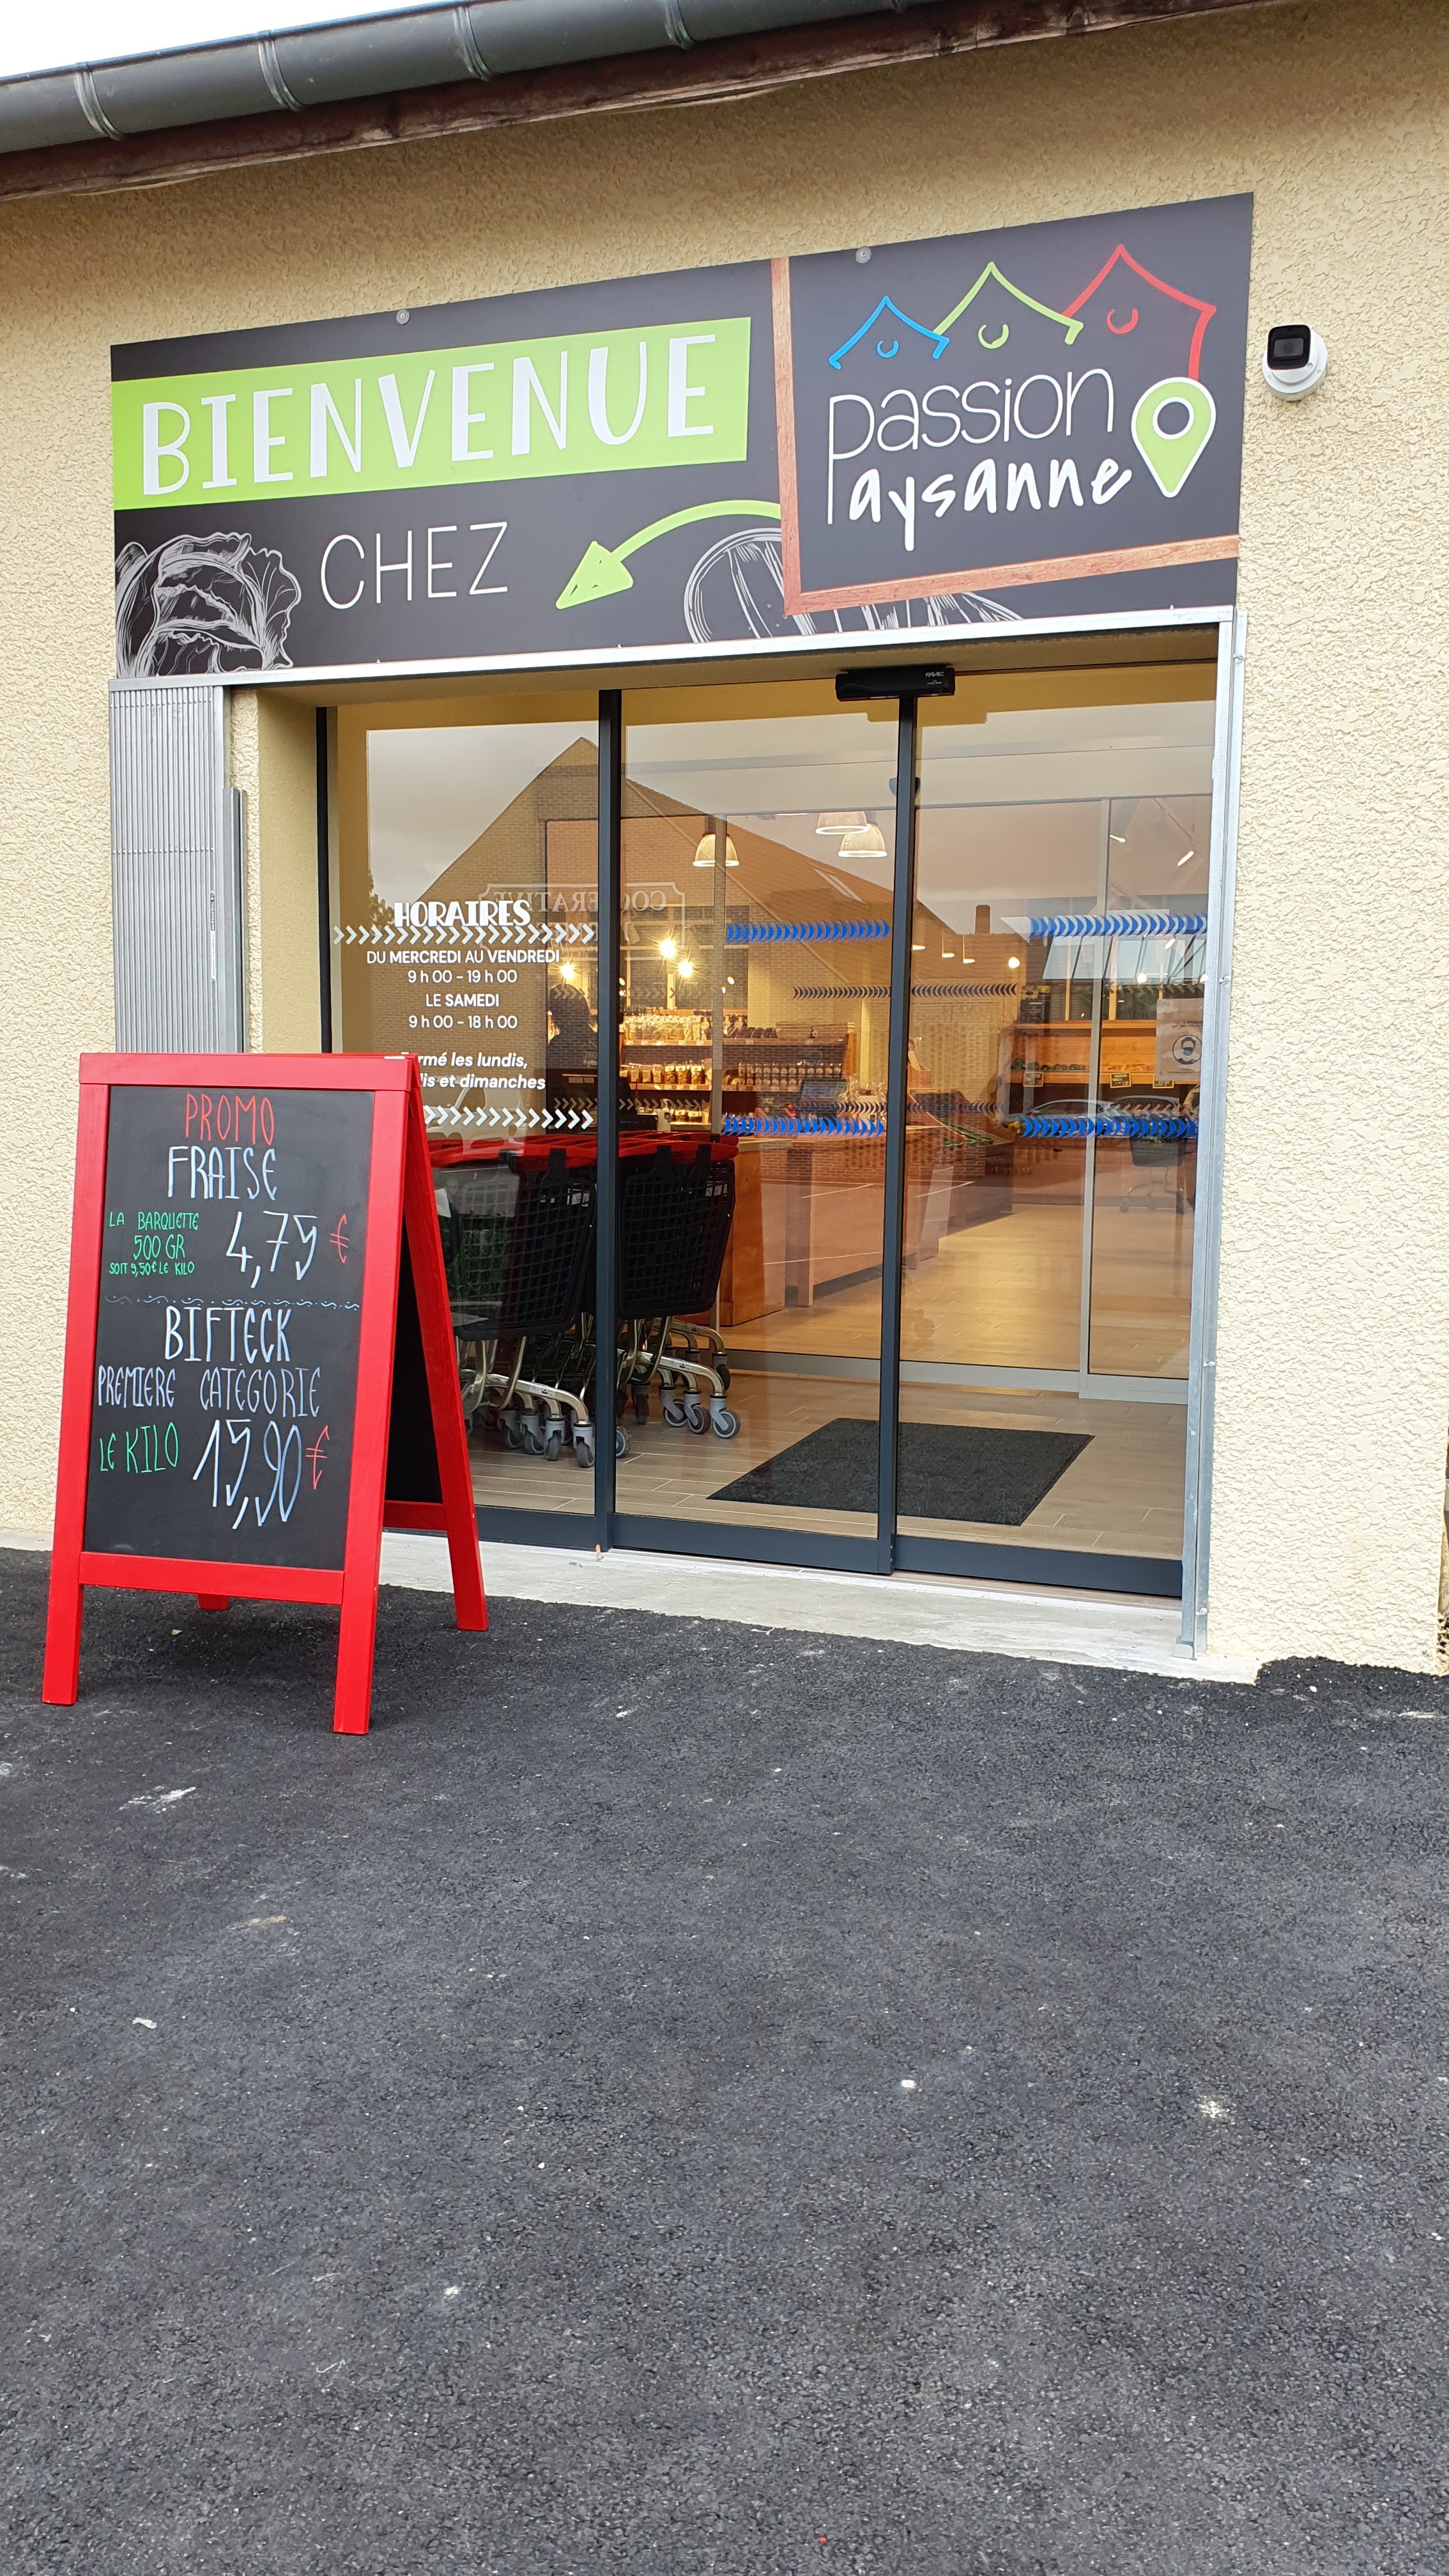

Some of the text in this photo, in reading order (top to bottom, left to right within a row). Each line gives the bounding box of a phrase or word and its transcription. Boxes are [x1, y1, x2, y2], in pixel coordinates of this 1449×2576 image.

[142, 334, 716, 495] BIENVENUE
[828, 368, 1115, 459] passion
[321, 522, 508, 610] CHEZ
[394, 900, 531, 928] HORAIRES
[366, 949, 560, 963] DU MERCREDI AU VENDREDI
[408, 970, 417, 983] 9
[421, 970, 430, 983] h
[432, 970, 452, 983] 00
[468, 970, 482, 983] 19
[485, 970, 493, 983] h
[496, 970, 518, 983] 00
[425, 994, 500, 1008] LE SAMEDI
[408, 1015, 418, 1029] 9
[422, 1015, 430, 1029] h
[433, 1015, 453, 1029] 00
[468, 1015, 482, 1029] 18
[486, 1015, 494, 1029] h
[497, 1015, 518, 1029] 00
[417, 1052, 528, 1070] rmé les lundis,
[440, 1075, 456, 1087] et
[459, 1073, 546, 1090] dimanches
[185, 1093, 275, 1146] PROMO
[167, 1146, 277, 1200] FRAISE
[109, 1211, 199, 1230] LA BARQUETTE
[132, 1234, 186, 1261] 500 GR
[225, 1210, 349, 1289] 4,75 €
[109, 1262, 128, 1275] SOIT
[158, 1262, 169, 1275] LE
[174, 1261, 195, 1276] KILO
[164, 1305, 293, 1363] BIFTECK
[97, 1365, 176, 1408] PREMIERE
[100, 1422, 180, 1473] LE KILO
[192, 1419, 330, 1529] 15,90 €
